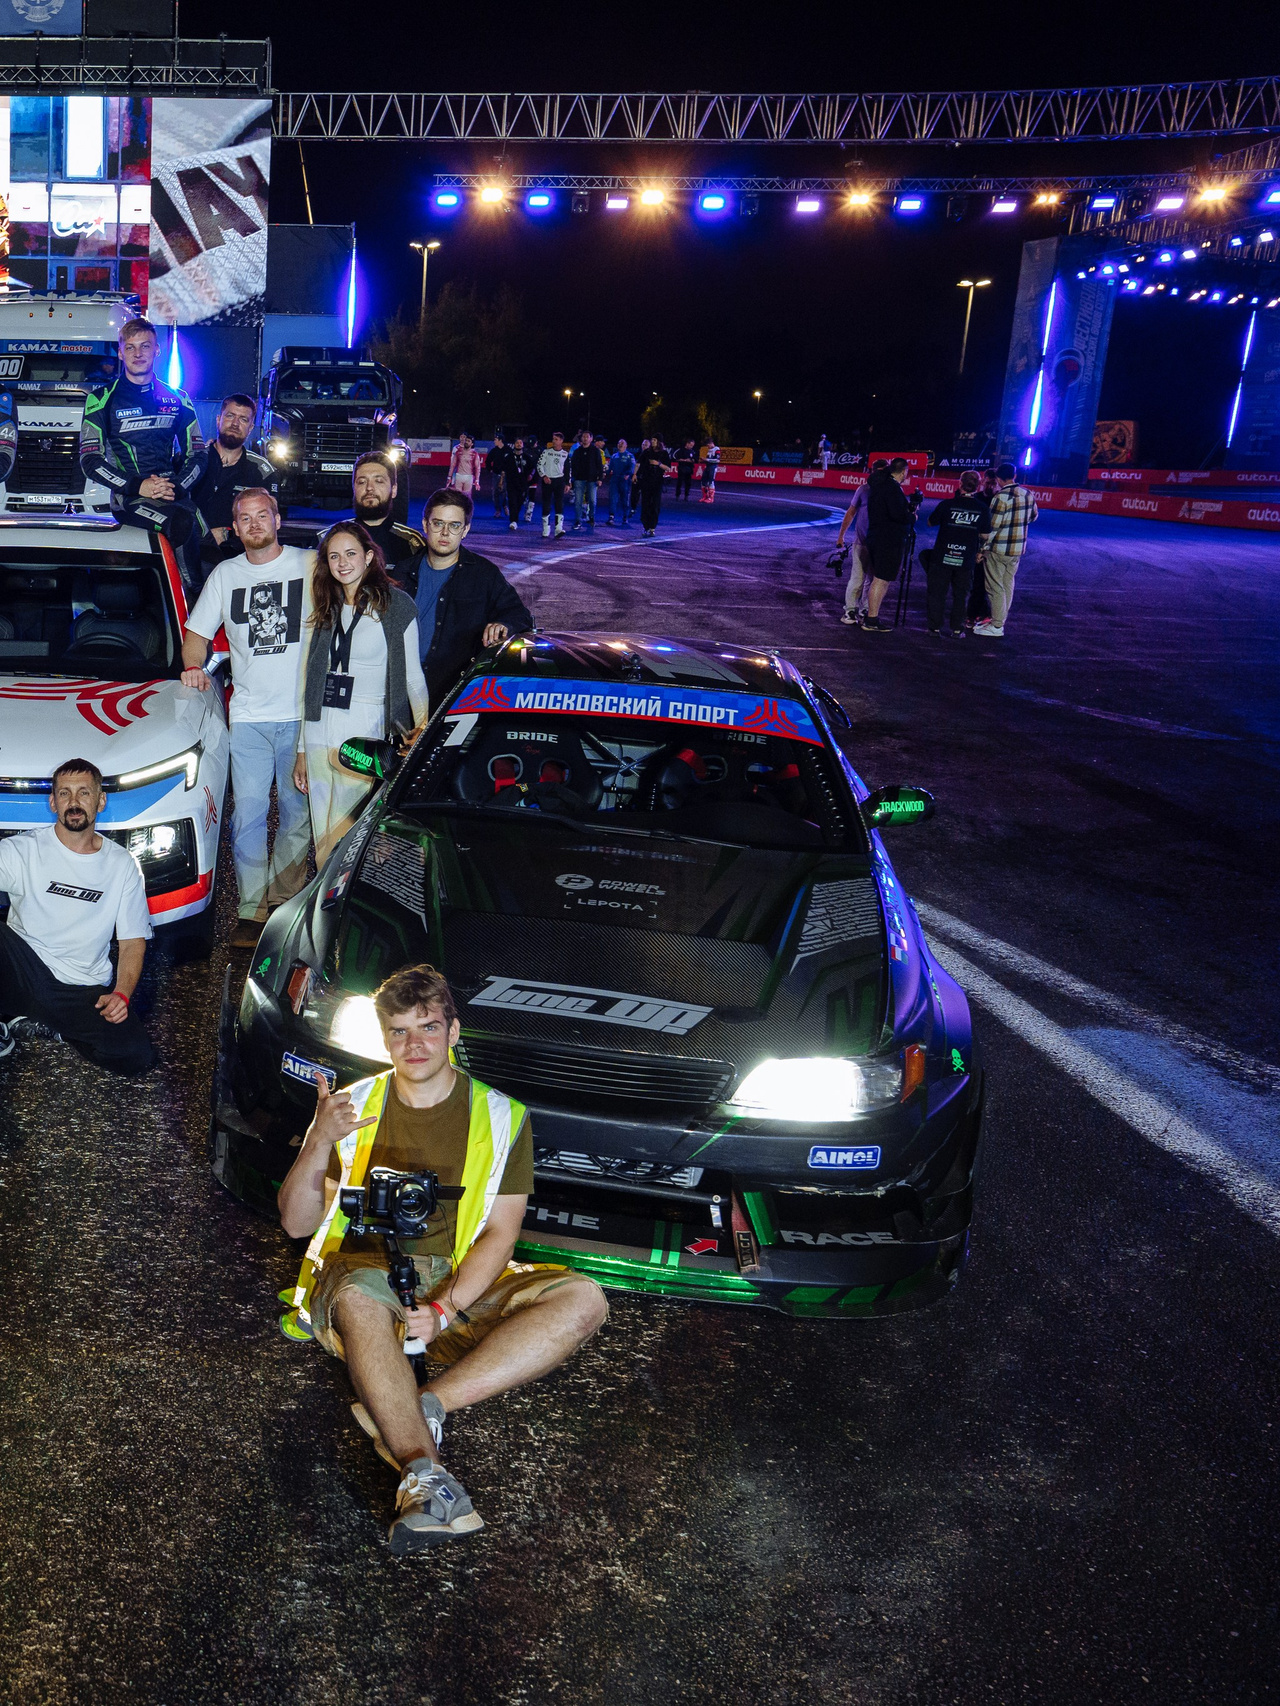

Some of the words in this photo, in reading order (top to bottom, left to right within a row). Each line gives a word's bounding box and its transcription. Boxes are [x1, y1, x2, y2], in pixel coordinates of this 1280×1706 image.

[8, 343, 58, 352] KAMAZ
[61, 345, 93, 353] master
[18, 383, 41, 391] KAMAZ
[118, 409, 141, 417] AIMOL
[0, 427, 15, 441] 44
[745, 469, 775, 479] auto.ru
[1101, 471, 1142, 480] auto.ru
[926, 482, 954, 493] auto.ru
[1032, 491, 1052, 502] to.ru
[1122, 498, 1158, 512] auto.ru
[950, 510, 981, 522] TEAM
[1248, 508, 1280, 524] auto.
[947, 543, 967, 551] LECAR
[515, 692, 662, 719] МОСКОВСКИЙ
[669, 701, 739, 727] СПОРТ
[506, 731, 558, 744] BRIDE
[340, 743, 373, 768] TRACKWOOD
[879, 800, 925, 813] TRACKWOOD
[45, 880, 82, 899] Time
[598, 882, 666, 896] WHEELS
[599, 879, 660, 891] POWER
[578, 898, 644, 911] LEPOTA
[468, 975, 598, 1018] Time
[813, 1149, 877, 1165] AIMOL
[779, 1230, 903, 1246] RACE
